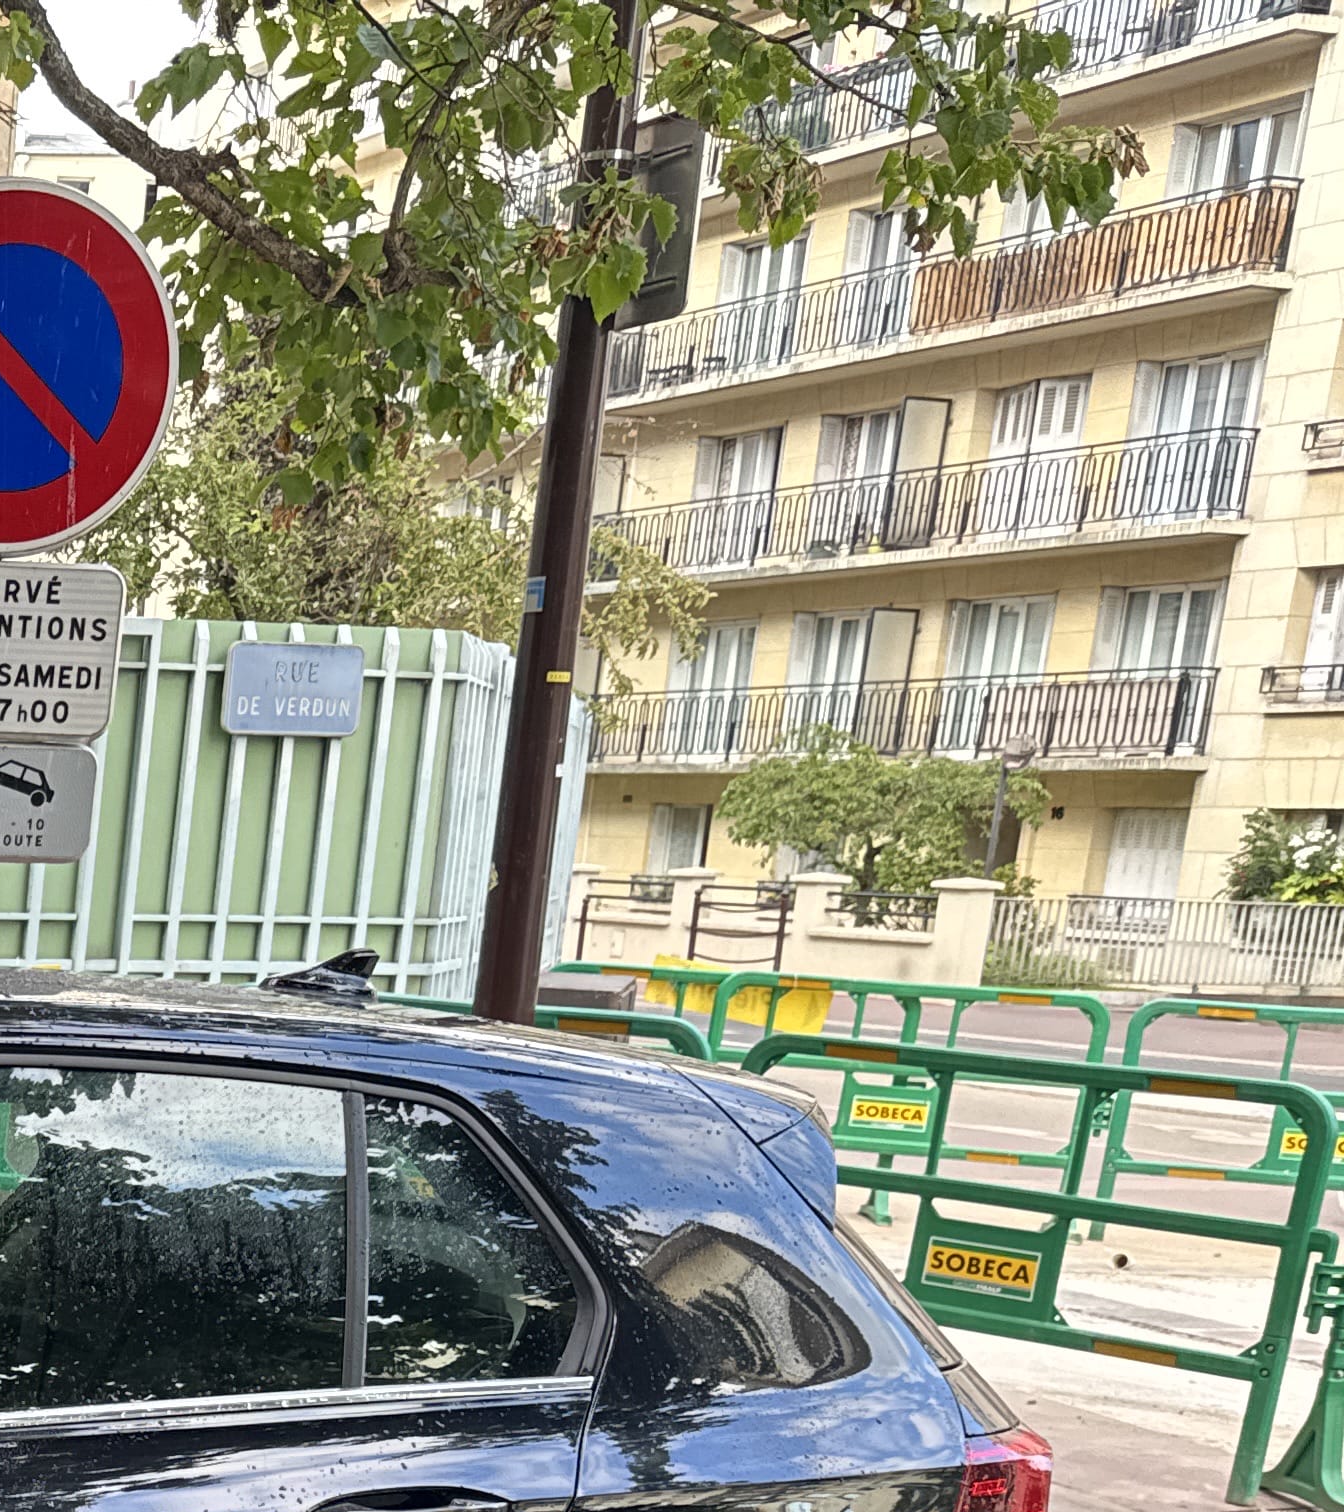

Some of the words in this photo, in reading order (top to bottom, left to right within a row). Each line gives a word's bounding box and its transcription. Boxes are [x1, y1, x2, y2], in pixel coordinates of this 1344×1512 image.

[274, 660, 320, 684] RUE
[236, 696, 261, 716] DE
[274, 696, 351, 717] VERDUN
[855, 1104, 923, 1121] SOBECA
[930, 1250, 1030, 1284] SOBECA
